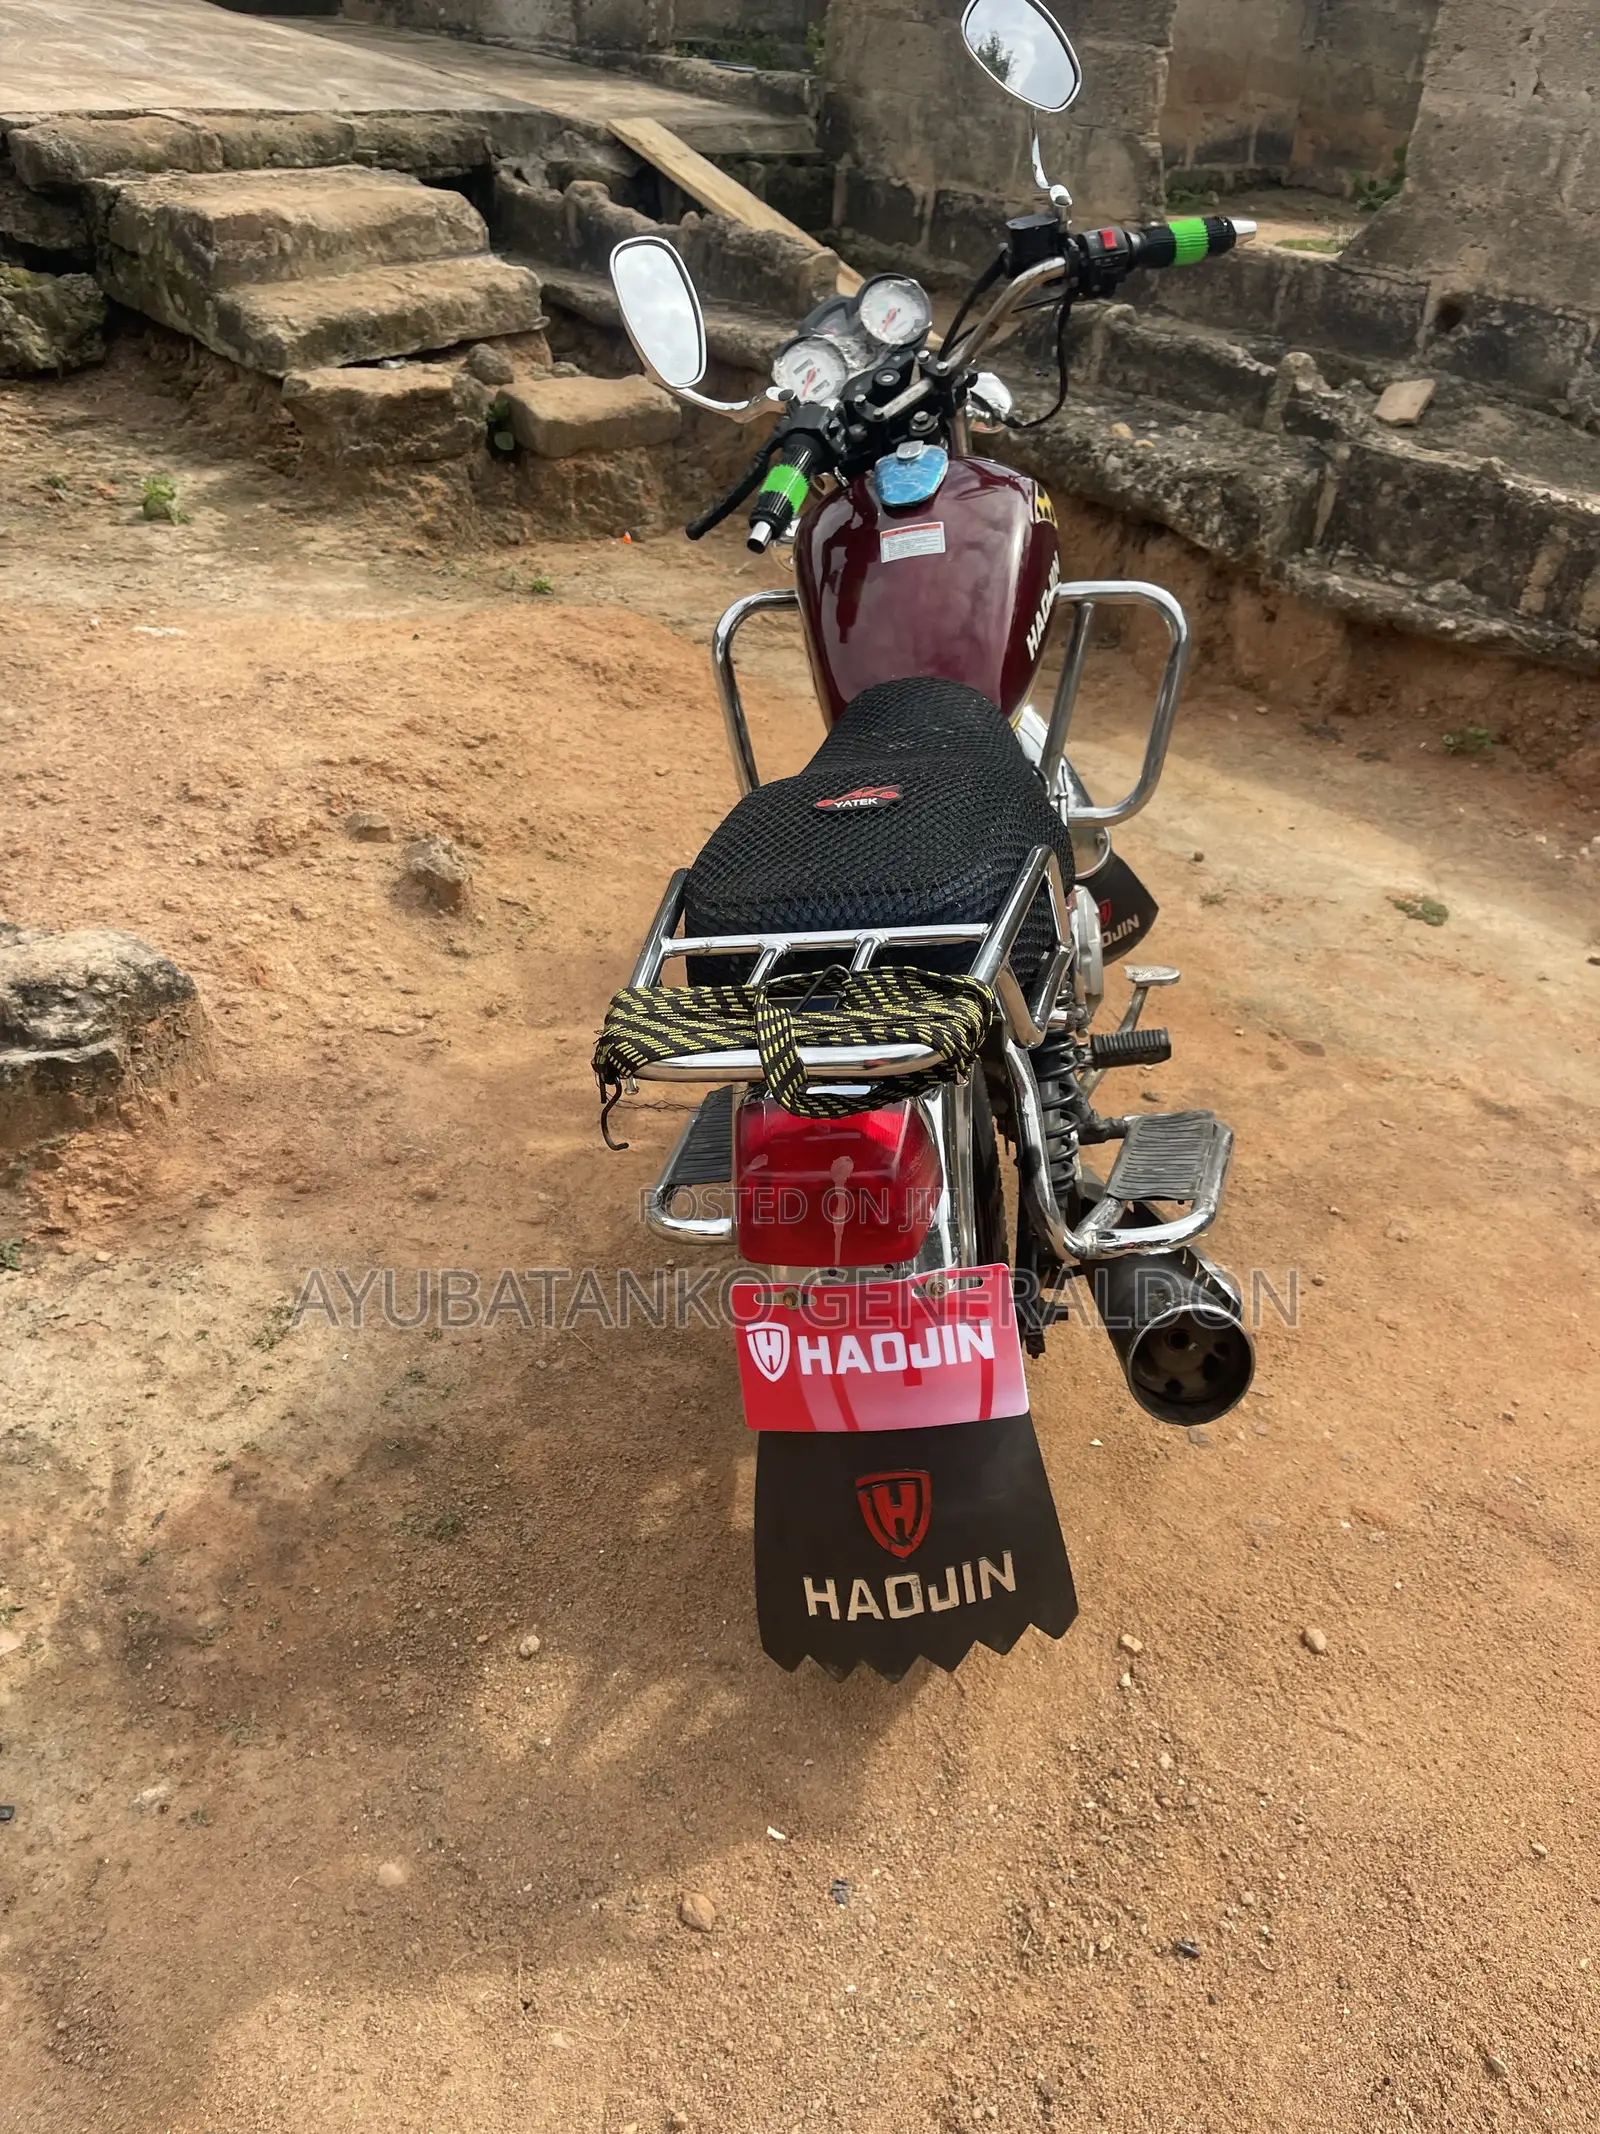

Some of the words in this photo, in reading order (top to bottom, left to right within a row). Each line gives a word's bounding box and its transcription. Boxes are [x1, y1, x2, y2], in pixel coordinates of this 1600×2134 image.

[834, 797, 878, 808] YATEK
[1101, 913, 1140, 948] OJIN
[797, 1319, 995, 1375] HAOJIN
[803, 1550, 1016, 1621] HAOJIN
